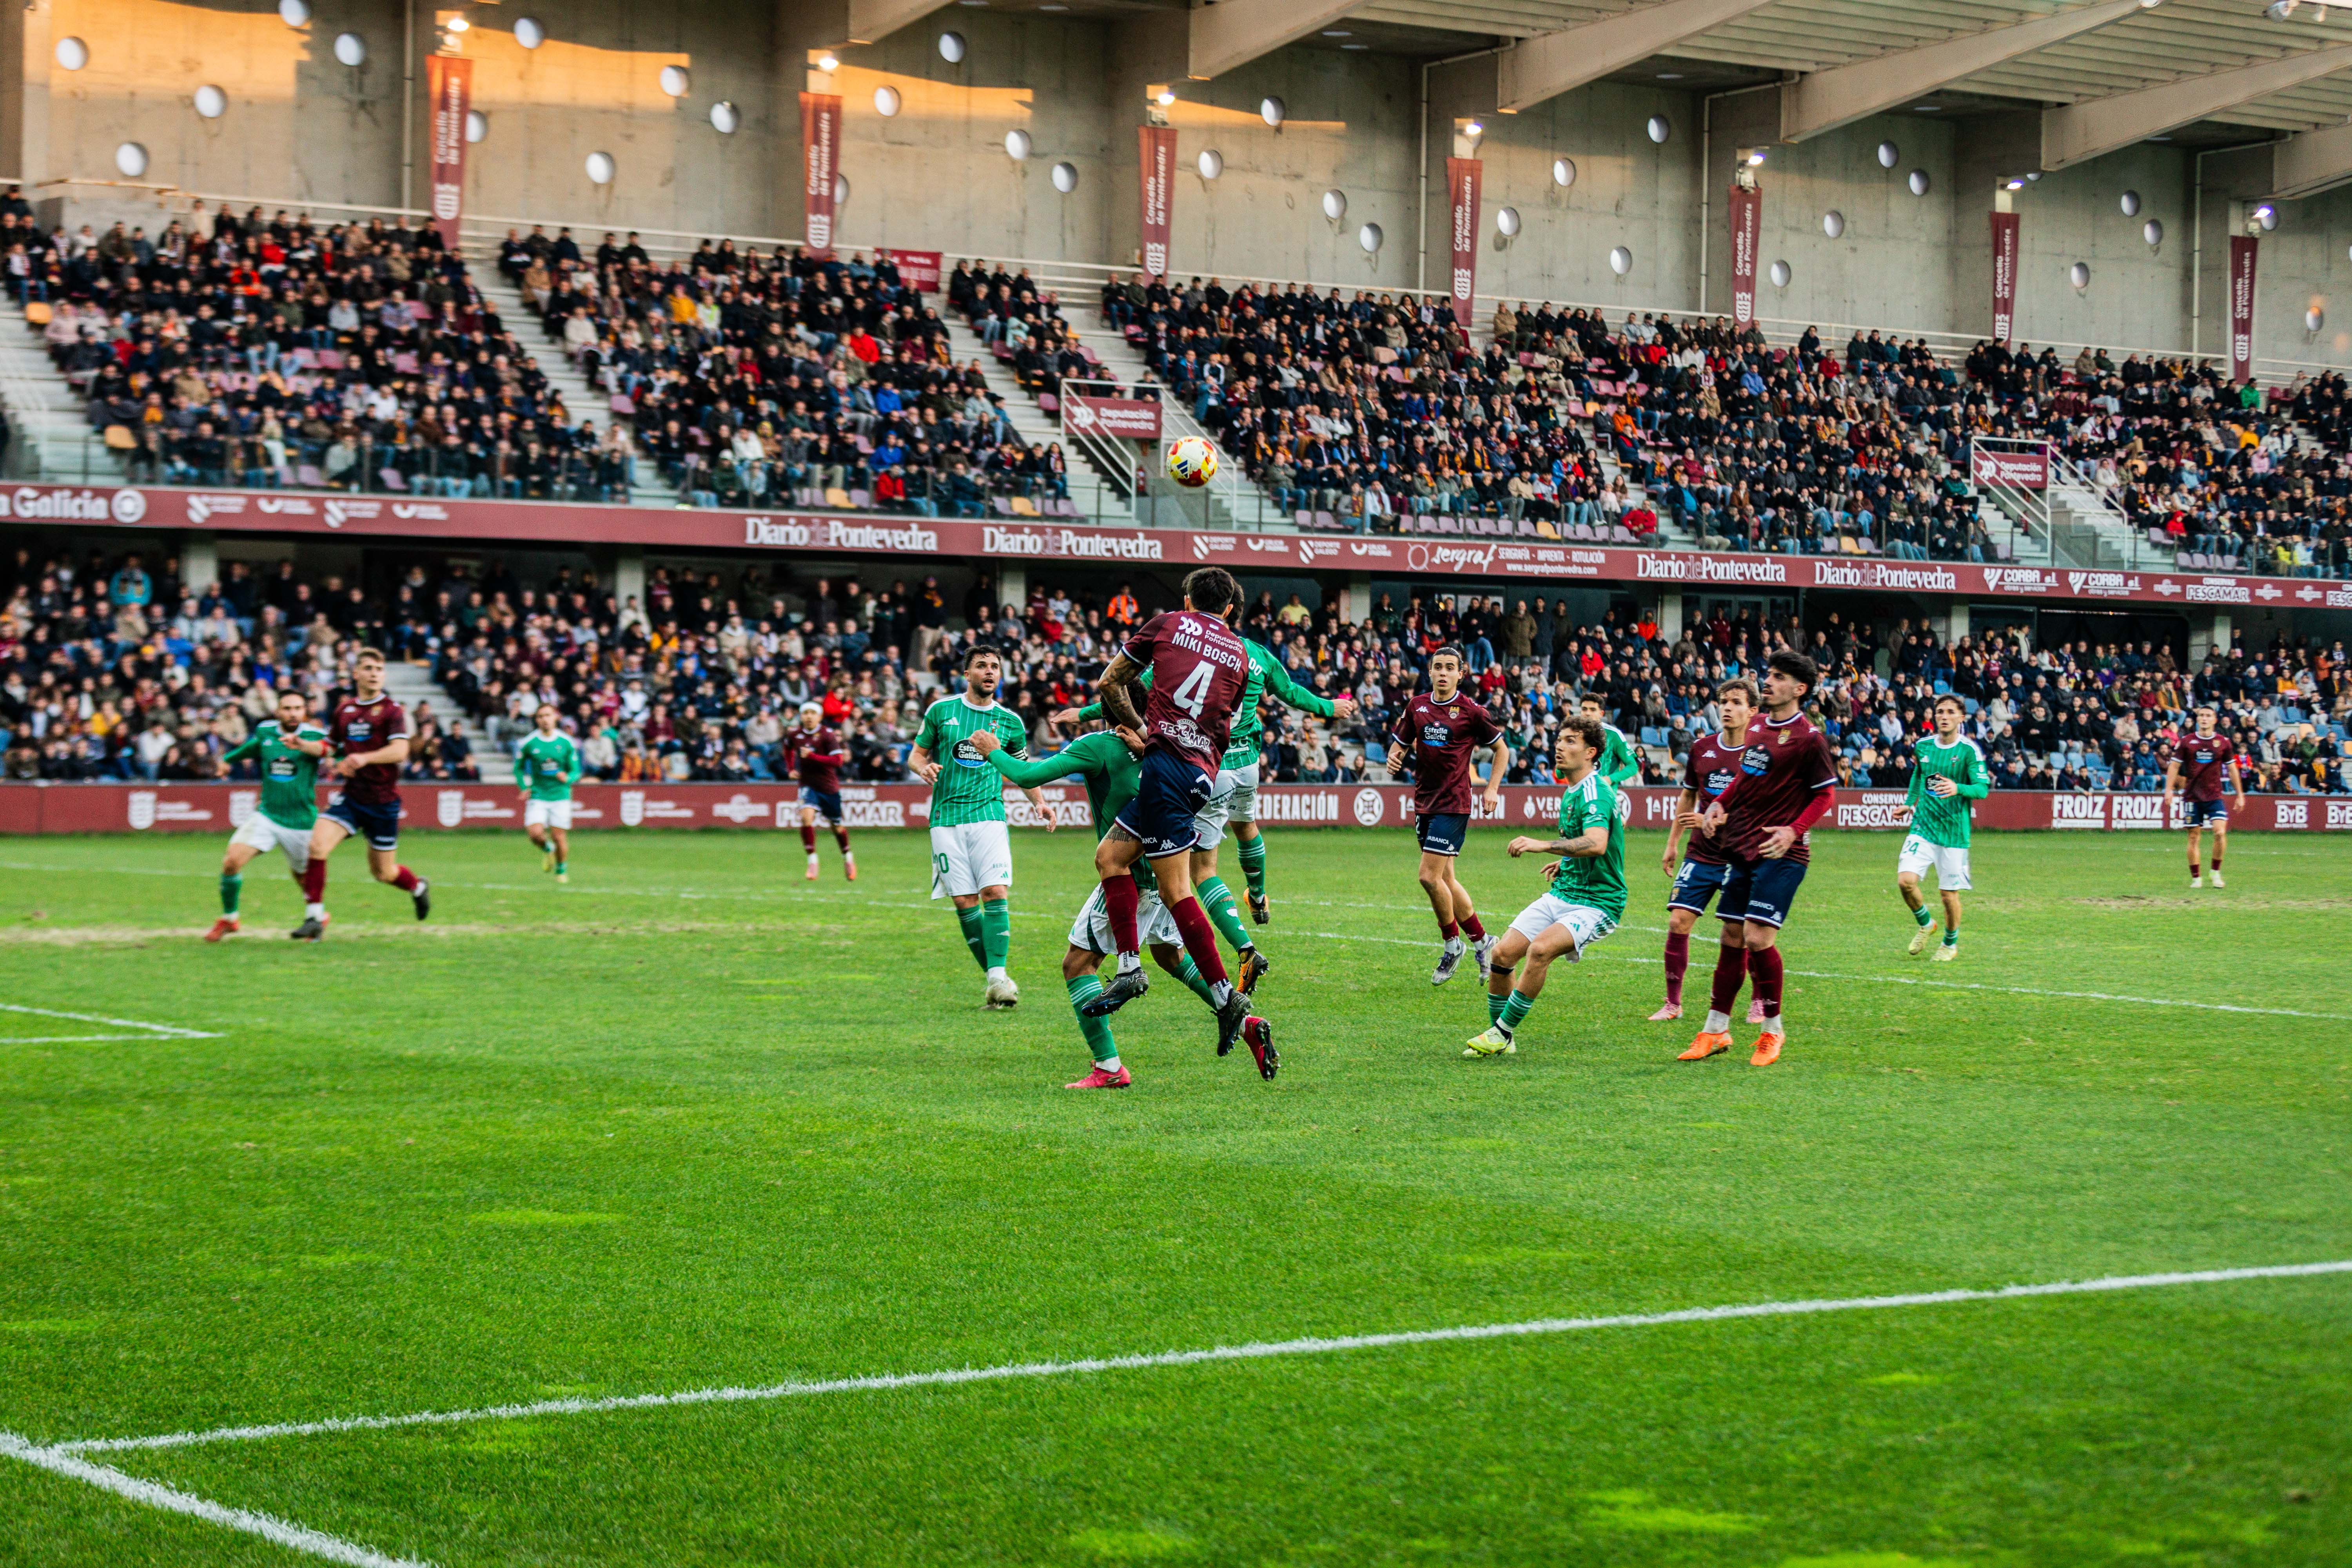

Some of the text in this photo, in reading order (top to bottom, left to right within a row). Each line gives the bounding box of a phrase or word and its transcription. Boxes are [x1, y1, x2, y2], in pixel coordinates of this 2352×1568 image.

[13, 487, 109, 520] Galicia
[1431, 543, 1497, 573] sergraf
[2004, 569, 2040, 583] CORBA
[2088, 573, 2124, 586] CORBA
[2186, 584, 2251, 603] PESCAMAR
[1205, 635, 1242, 655] Pontevedra
[1206, 630, 1243, 650] Deputación
[1172, 632, 1241, 673] MIKI BOSCH
[1173, 660, 1216, 720] 4
[958, 751, 983, 760] Galicia
[1255, 791, 1339, 820] EDERACIÓN
[2053, 794, 2106, 818] FROIZ
[2112, 795, 2164, 819] FROIZ
[1427, 836, 1449, 844] ABANCA
[1675, 862, 1696, 881] 14
